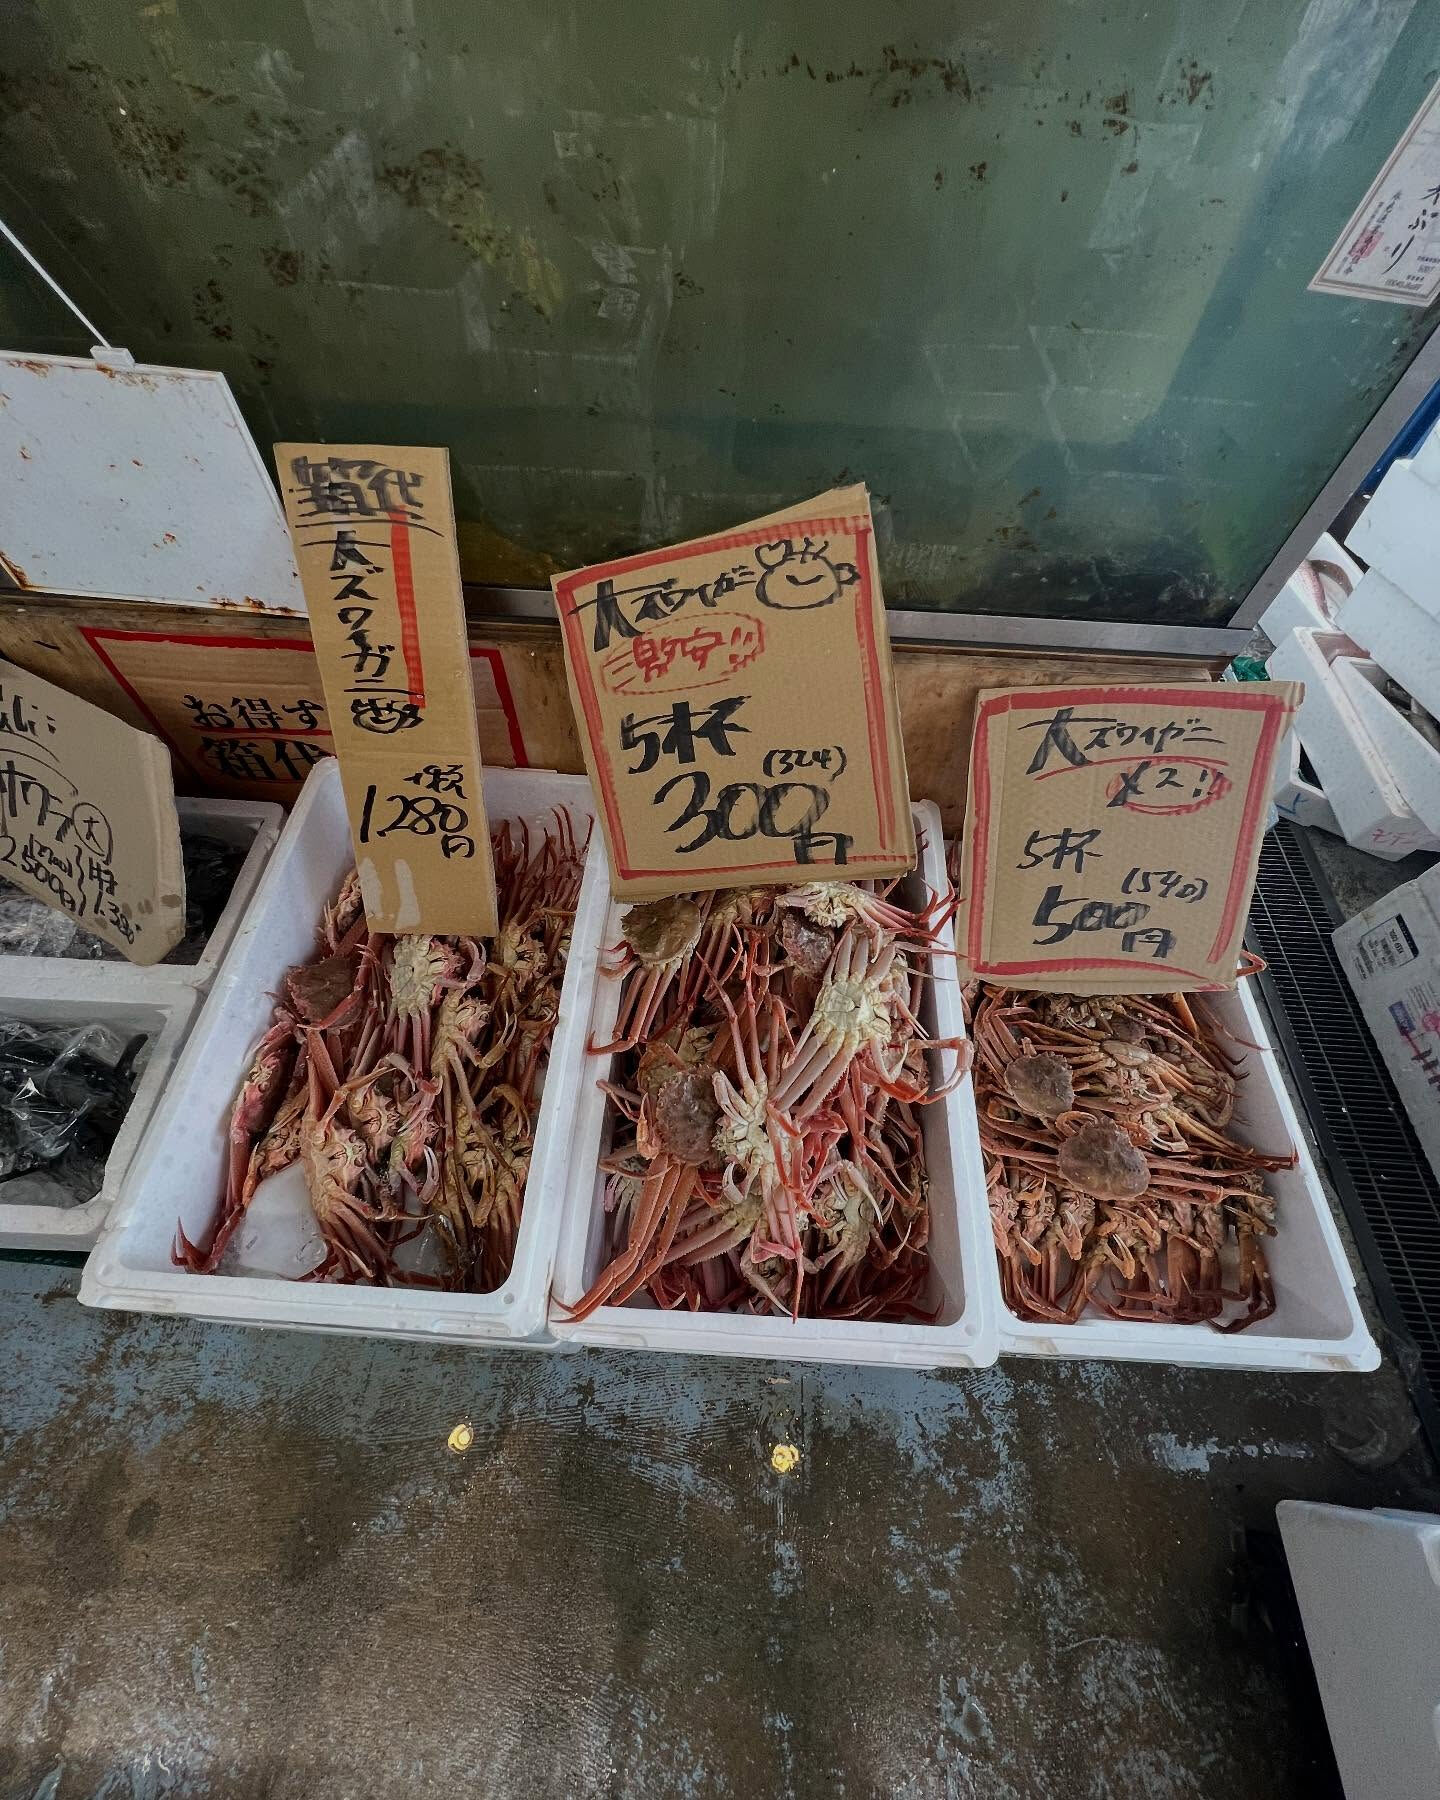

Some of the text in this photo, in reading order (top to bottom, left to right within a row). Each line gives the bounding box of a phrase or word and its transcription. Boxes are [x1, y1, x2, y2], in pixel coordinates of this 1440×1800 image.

[620, 696, 752, 775] 5杯
[763, 746, 847, 782] (324)
[653, 771, 854, 865] 300円
[1016, 828, 1103, 873] 5杯
[1121, 868, 1208, 903] (540)
[1032, 885, 1176, 959] 500円
